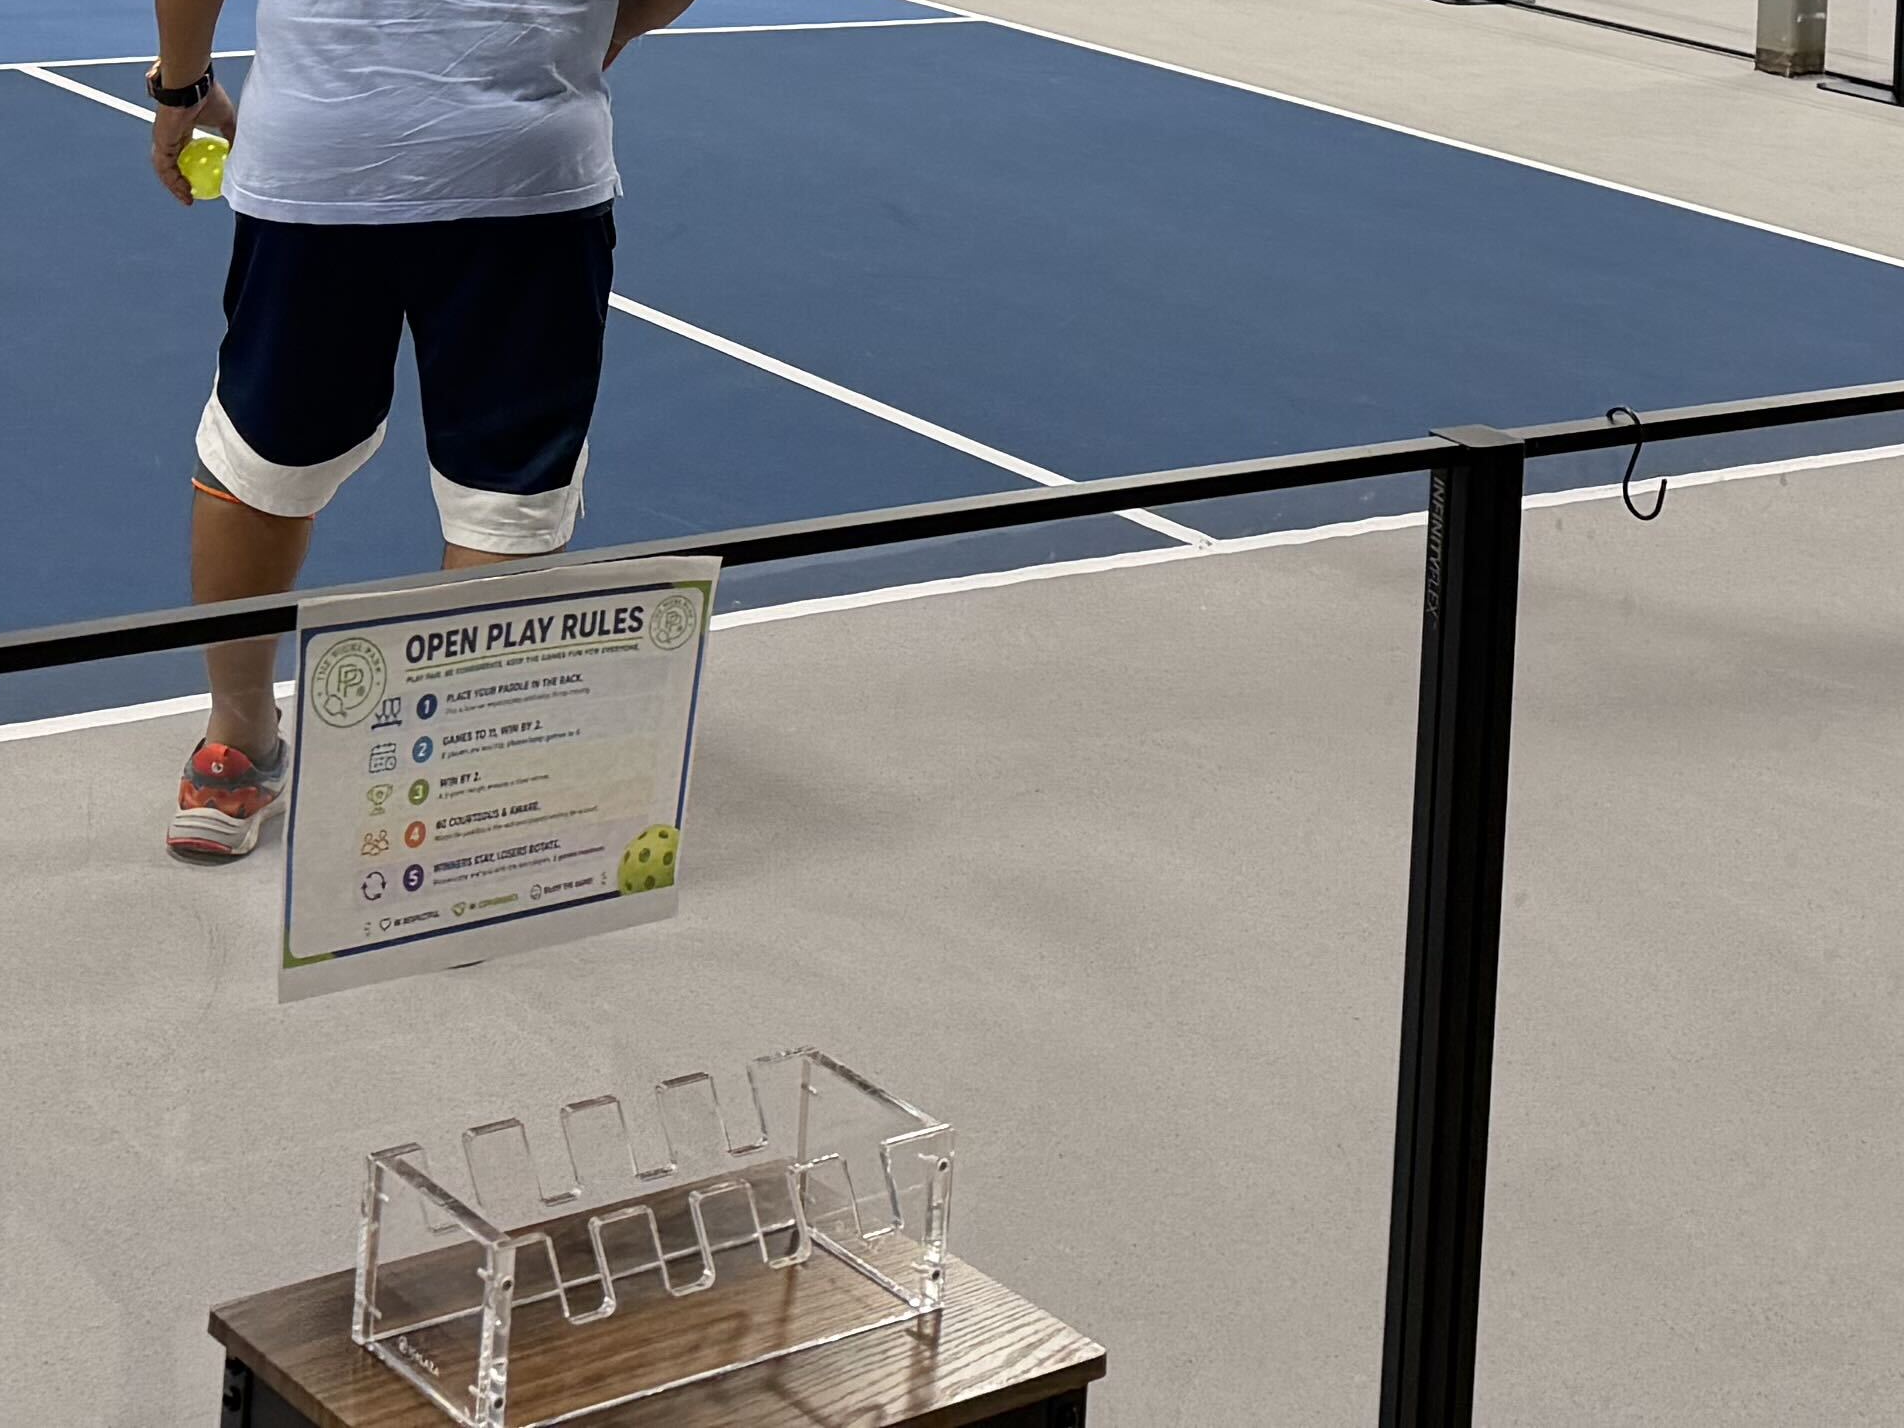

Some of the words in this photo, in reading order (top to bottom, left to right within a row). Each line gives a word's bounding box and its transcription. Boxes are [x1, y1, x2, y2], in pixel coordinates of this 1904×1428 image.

[406, 625, 478, 664] OPEN
[486, 615, 554, 651] PLAY
[560, 605, 644, 641] RULES
[424, 700, 432, 715] 1
[446, 689, 471, 703] PLACE
[498, 680, 529, 693] PADDLE
[543, 676, 558, 687] THE
[418, 743, 427, 757] 2
[443, 731, 472, 746] GAMES
[475, 729, 487, 739] TO
[415, 785, 423, 800] 3
[410, 828, 419, 841] 4
[409, 870, 418, 885] 5
